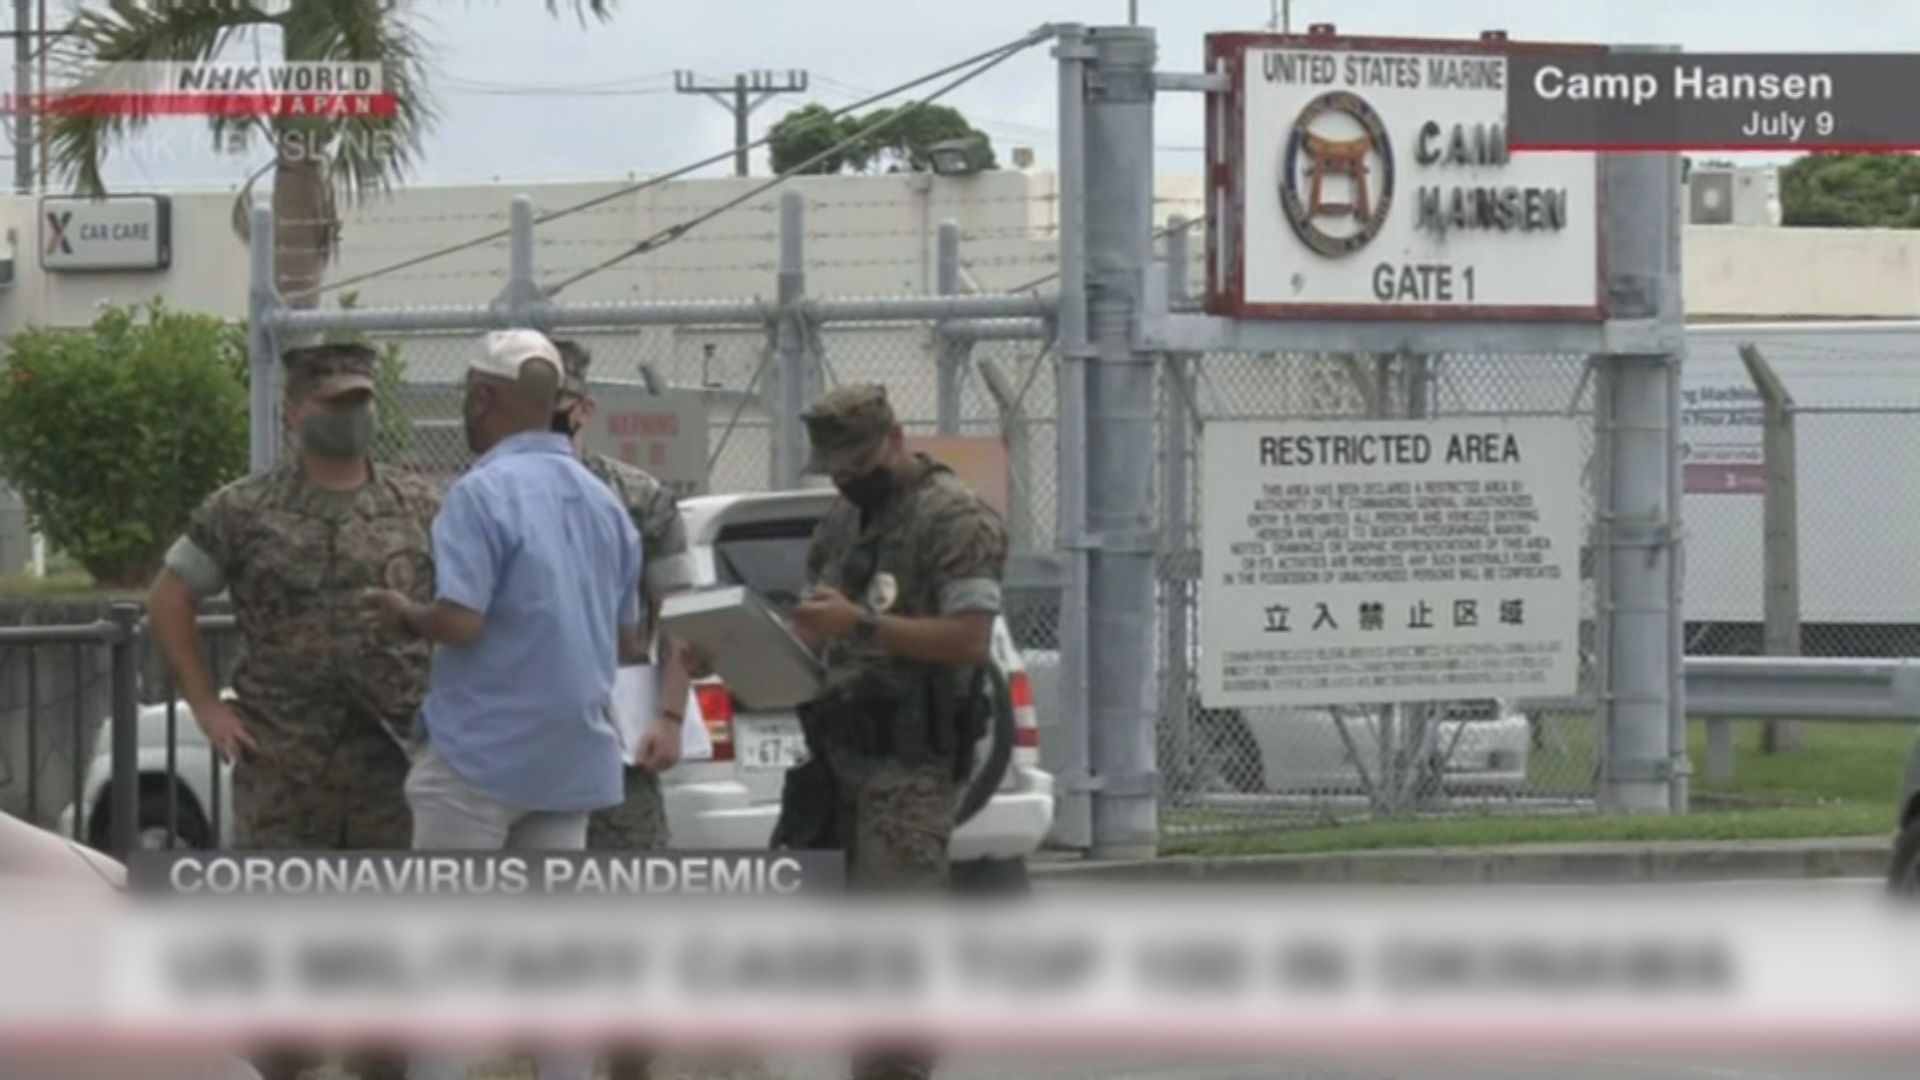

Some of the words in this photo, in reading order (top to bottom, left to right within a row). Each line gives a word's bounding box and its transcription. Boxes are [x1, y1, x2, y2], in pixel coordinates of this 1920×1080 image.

[1263, 52, 1336, 84] UNITED
[1344, 55, 1421, 88] STATES
[1428, 58, 1504, 90] MARINE
[1414, 185, 1568, 236] HANSEN
[80, 223, 109, 241] CAR
[112, 223, 149, 241] CARE
[1372, 262, 1453, 301] GATE
[1463, 266, 1475, 301] 1
[1260, 435, 1431, 466] RESTRICTED
[1445, 433, 1521, 463] AREA
[1263, 598, 1525, 633] 立入禁止区域
